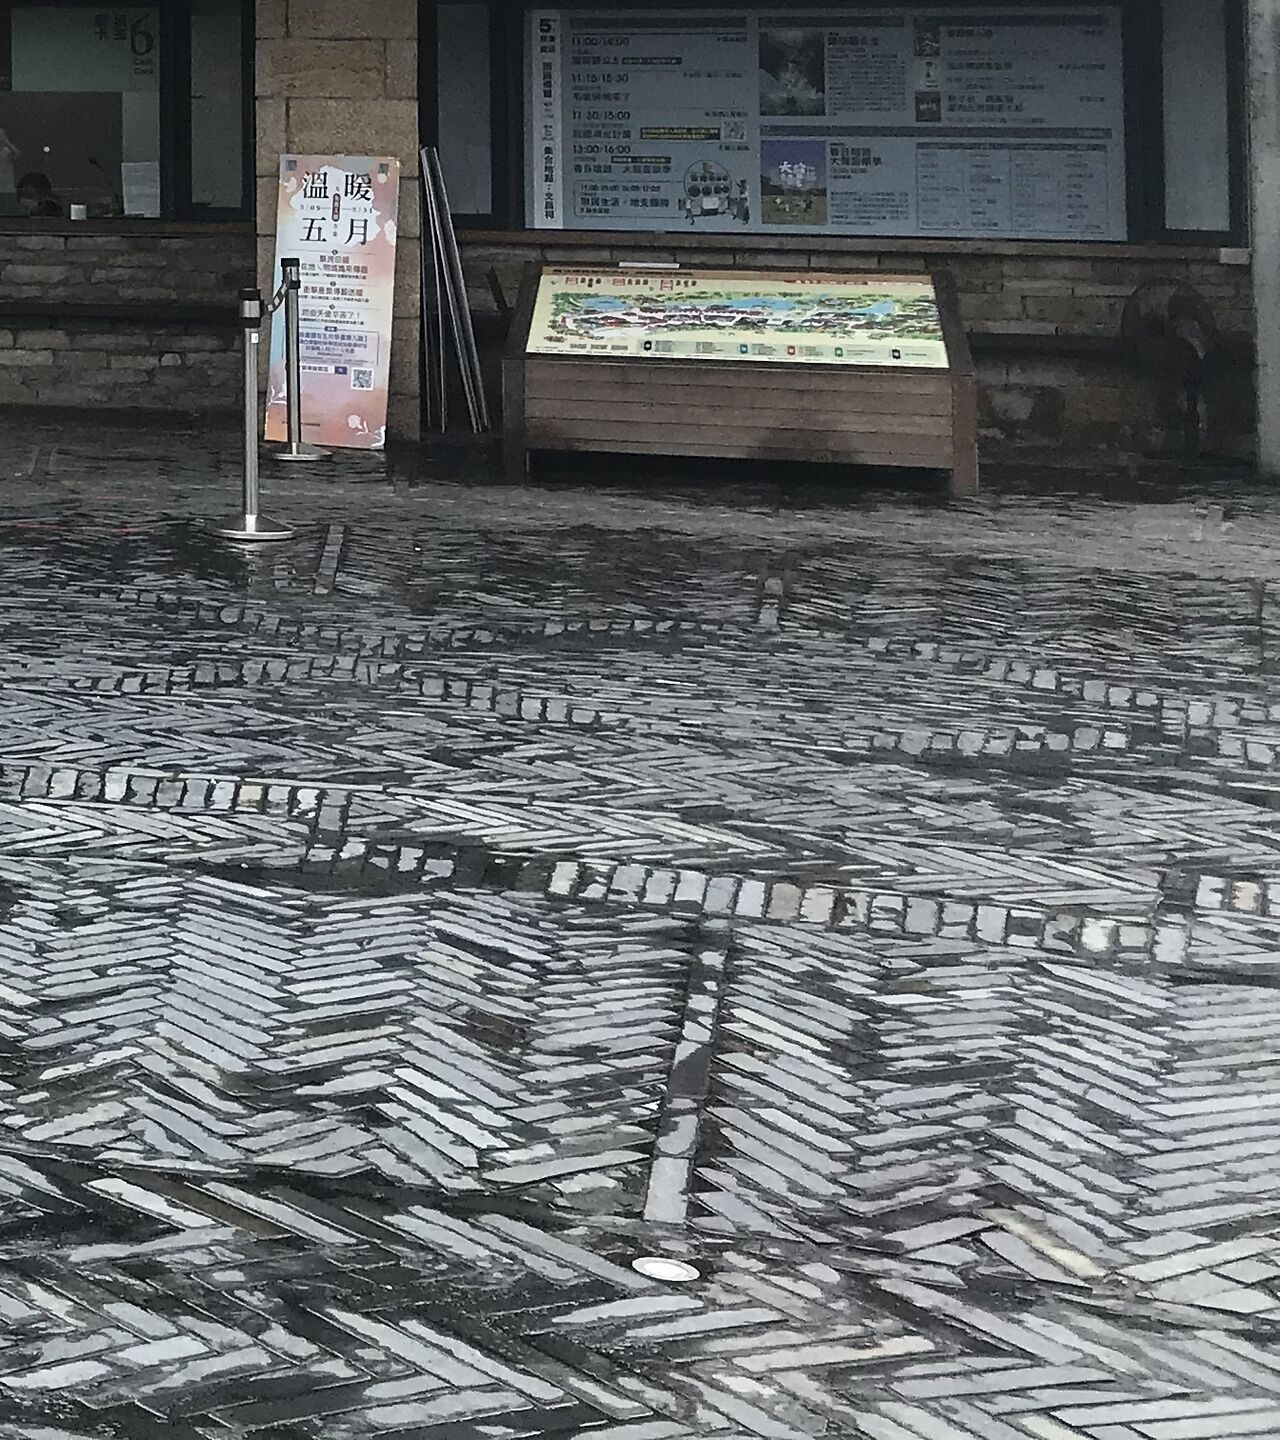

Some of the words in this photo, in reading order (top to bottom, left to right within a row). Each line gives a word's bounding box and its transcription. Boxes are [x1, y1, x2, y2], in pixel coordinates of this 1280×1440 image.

[130, 14, 154, 56] 6
[302, 170, 373, 202] 溫暖
[299, 216, 369, 246] 五月
